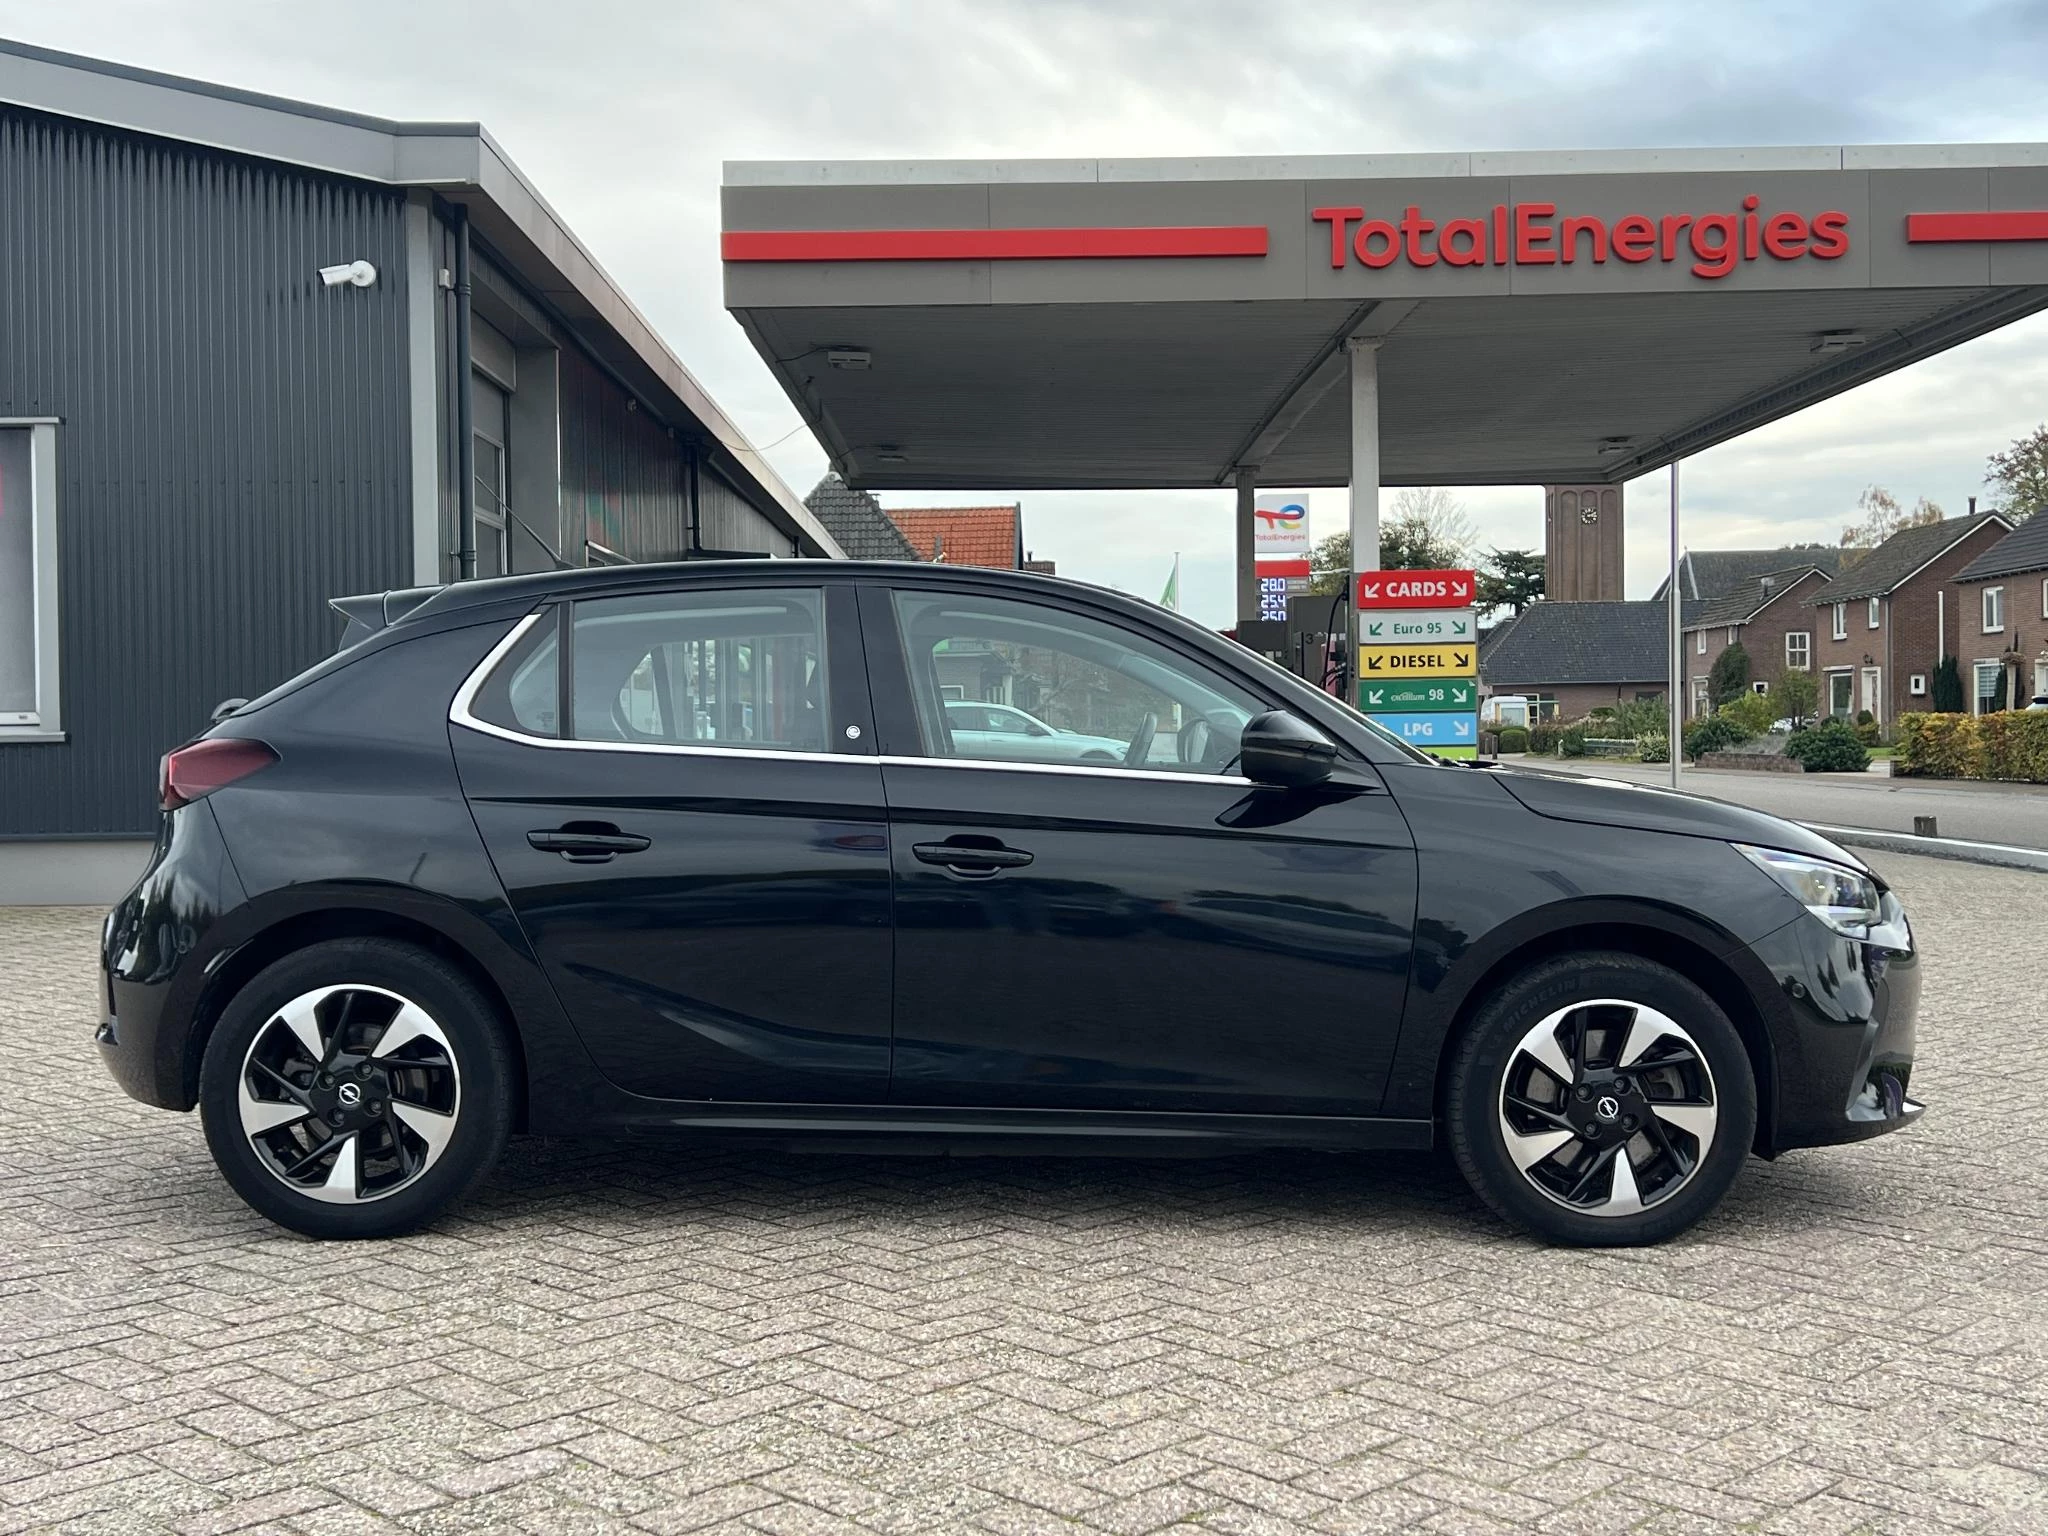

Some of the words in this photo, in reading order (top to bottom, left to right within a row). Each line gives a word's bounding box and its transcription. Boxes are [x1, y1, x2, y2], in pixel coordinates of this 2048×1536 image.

[1312, 195, 1850, 277] TotalEnergies
[1255, 533, 1306, 542] TotalEnergies
[1385, 581, 1447, 597] CARDS
[1393, 623, 1423, 634] Euro
[1427, 622, 1442, 634] 95
[1390, 655, 1445, 668] DIESEL
[1428, 689, 1445, 701] 98
[1403, 722, 1433, 736] LPG
